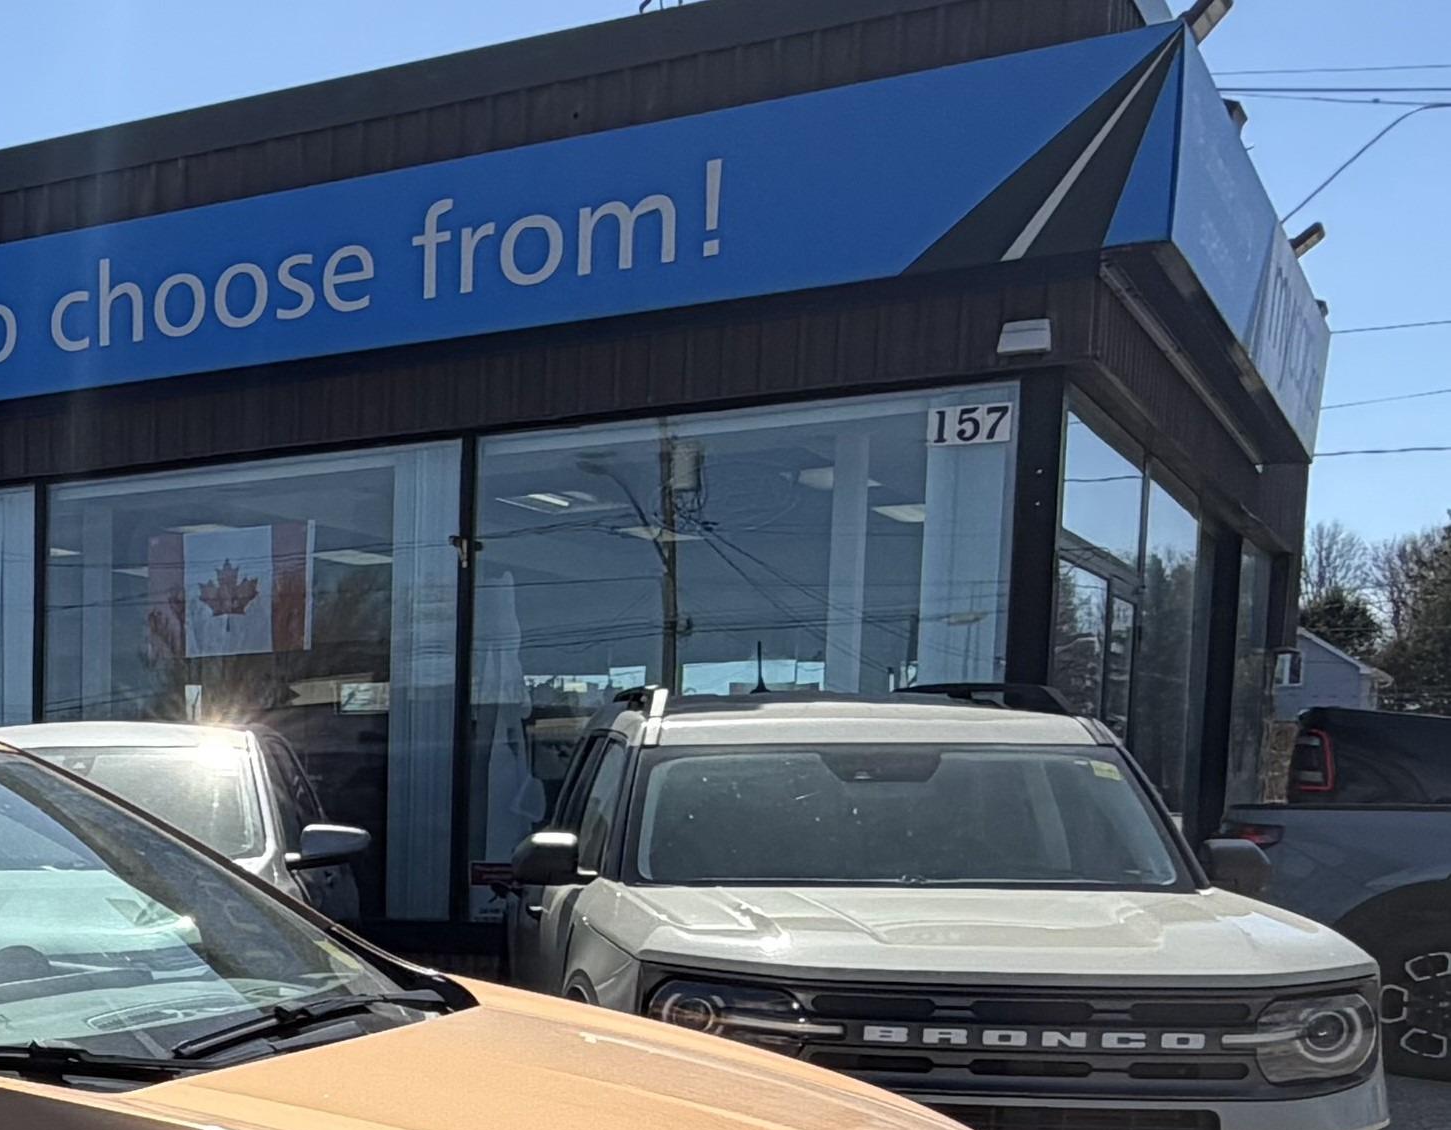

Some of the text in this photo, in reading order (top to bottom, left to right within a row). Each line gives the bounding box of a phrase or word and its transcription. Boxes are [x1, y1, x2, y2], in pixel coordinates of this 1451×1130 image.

[50, 243, 375, 352] choose
[411, 157, 723, 300] from!
[932, 404, 1011, 445] 157
[862, 1024, 1207, 1050] BRONCO
